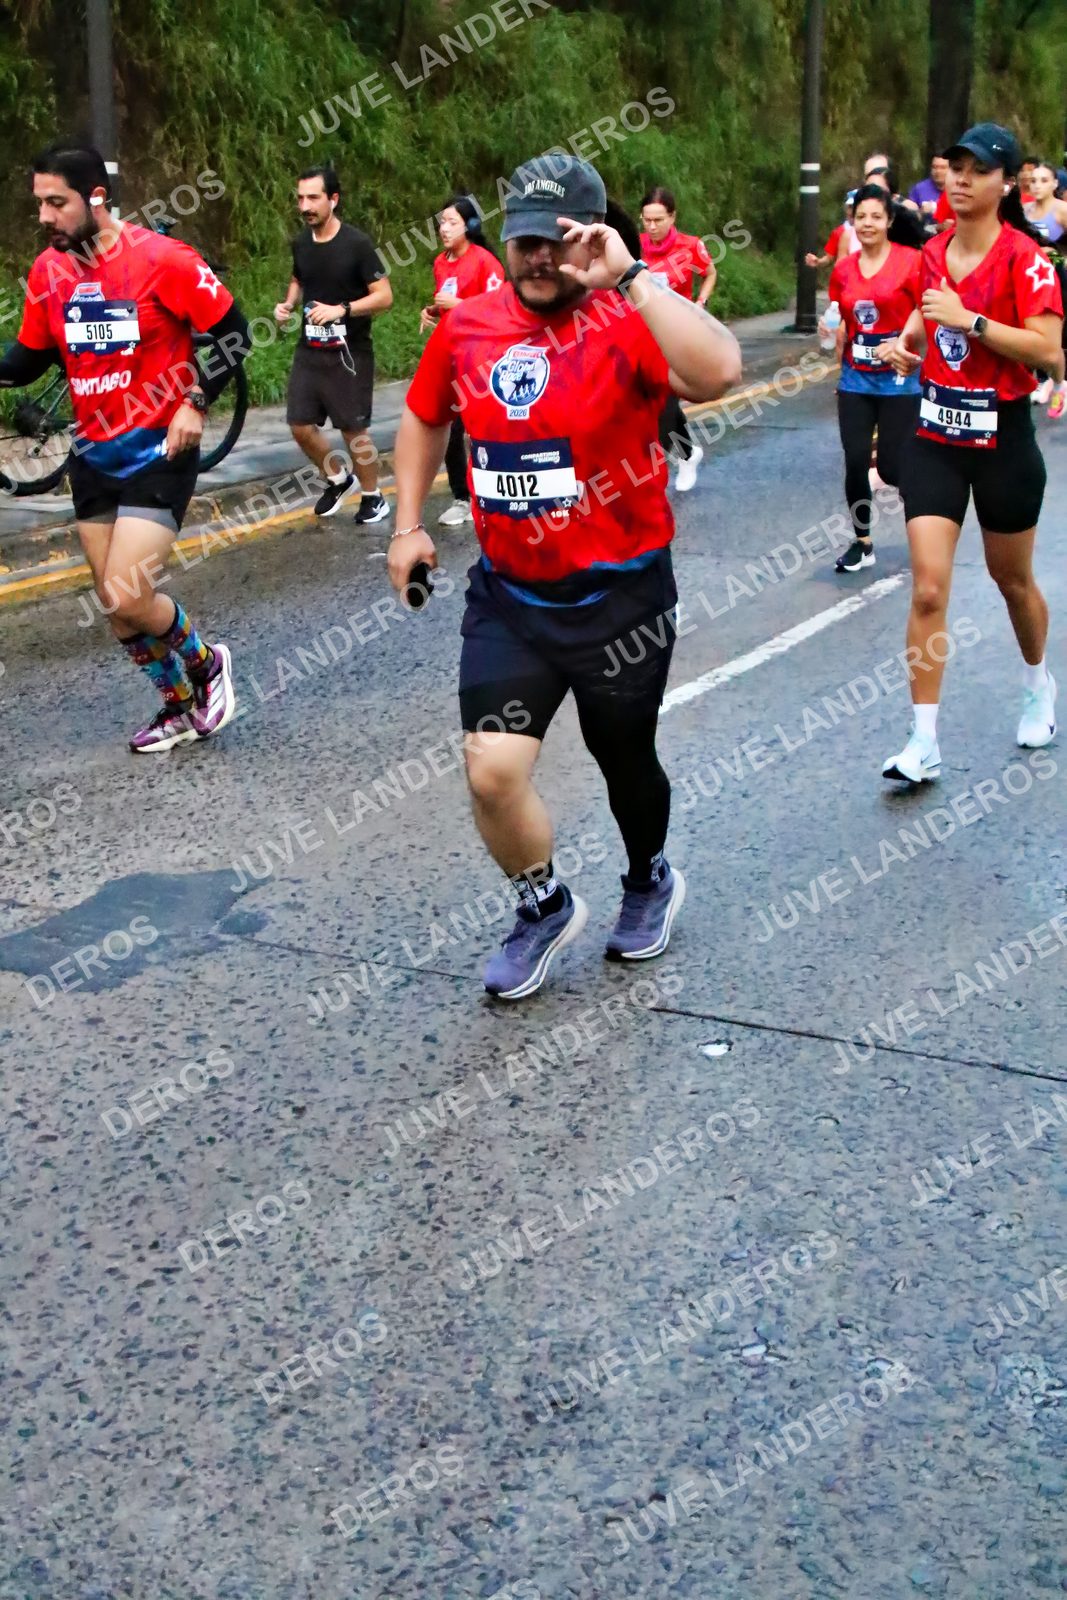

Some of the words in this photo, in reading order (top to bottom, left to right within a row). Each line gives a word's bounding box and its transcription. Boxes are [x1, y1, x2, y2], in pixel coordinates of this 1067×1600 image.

[535, 180, 565, 198] ANGELES
[86, 324, 113, 340] 5105
[70, 370, 132, 396] SANTIAGO
[509, 408, 527, 417] 2026
[937, 408, 971, 427] 4944
[496, 474, 539, 497] 4012
